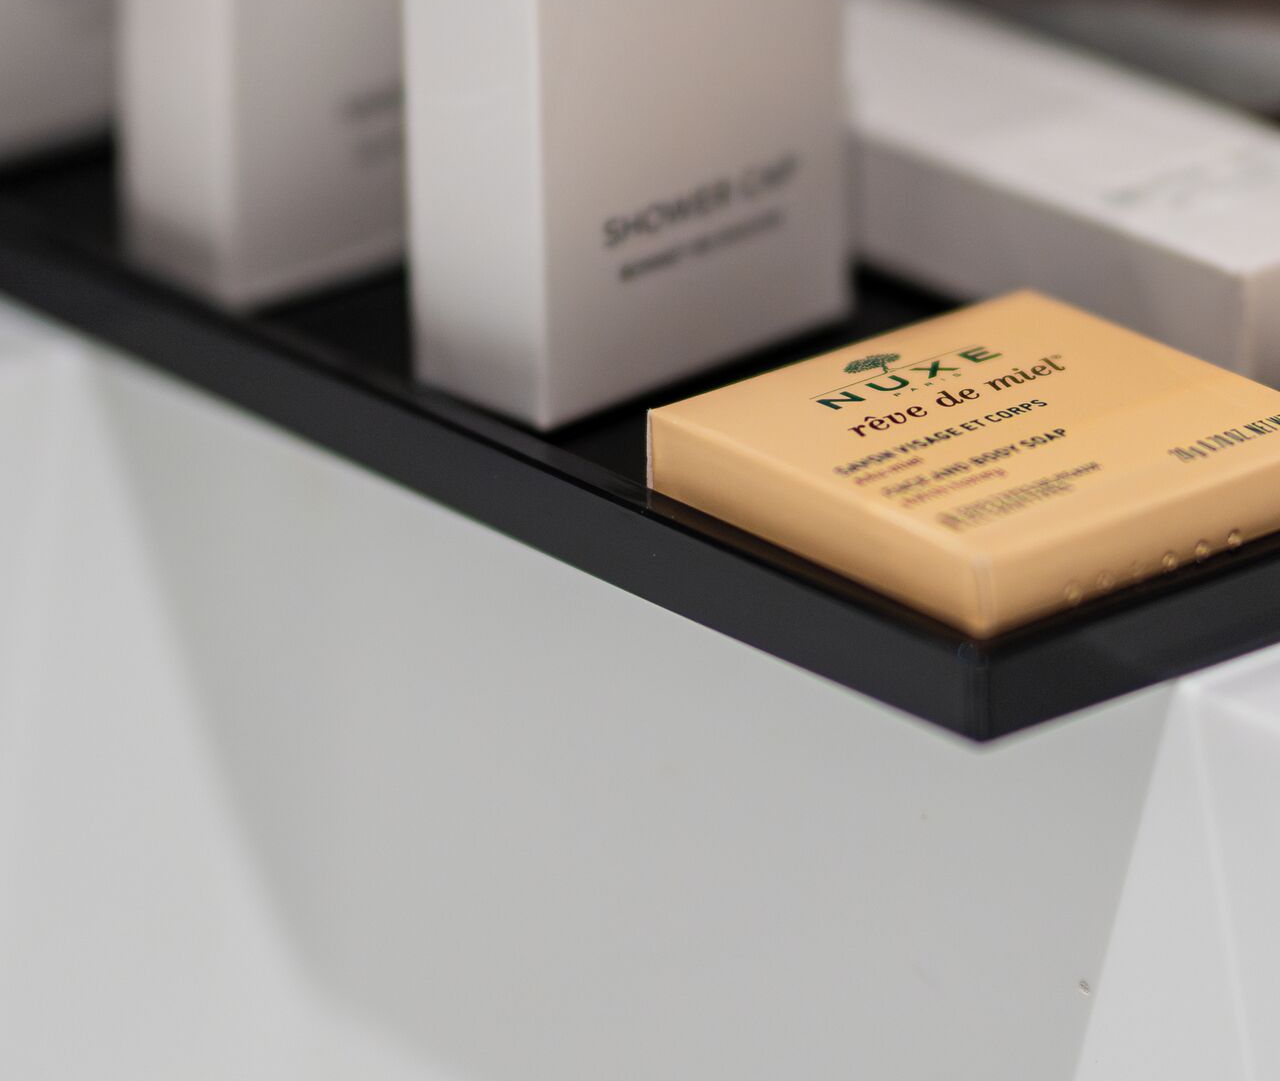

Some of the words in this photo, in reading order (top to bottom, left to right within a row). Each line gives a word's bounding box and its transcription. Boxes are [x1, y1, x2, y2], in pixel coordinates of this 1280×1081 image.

[816, 345, 1003, 410] NUXE
[893, 372, 962, 397] PARIS
[848, 405, 928, 439] rêve
[936, 385, 981, 409] de
[893, 428, 964, 455] VISAGE
[960, 418, 987, 432] ET
[983, 398, 1048, 423] CORPS
[1243, 419, 1279, 437] NET
[970, 444, 1022, 467] BODY
[1019, 427, 1068, 449] SOAP
